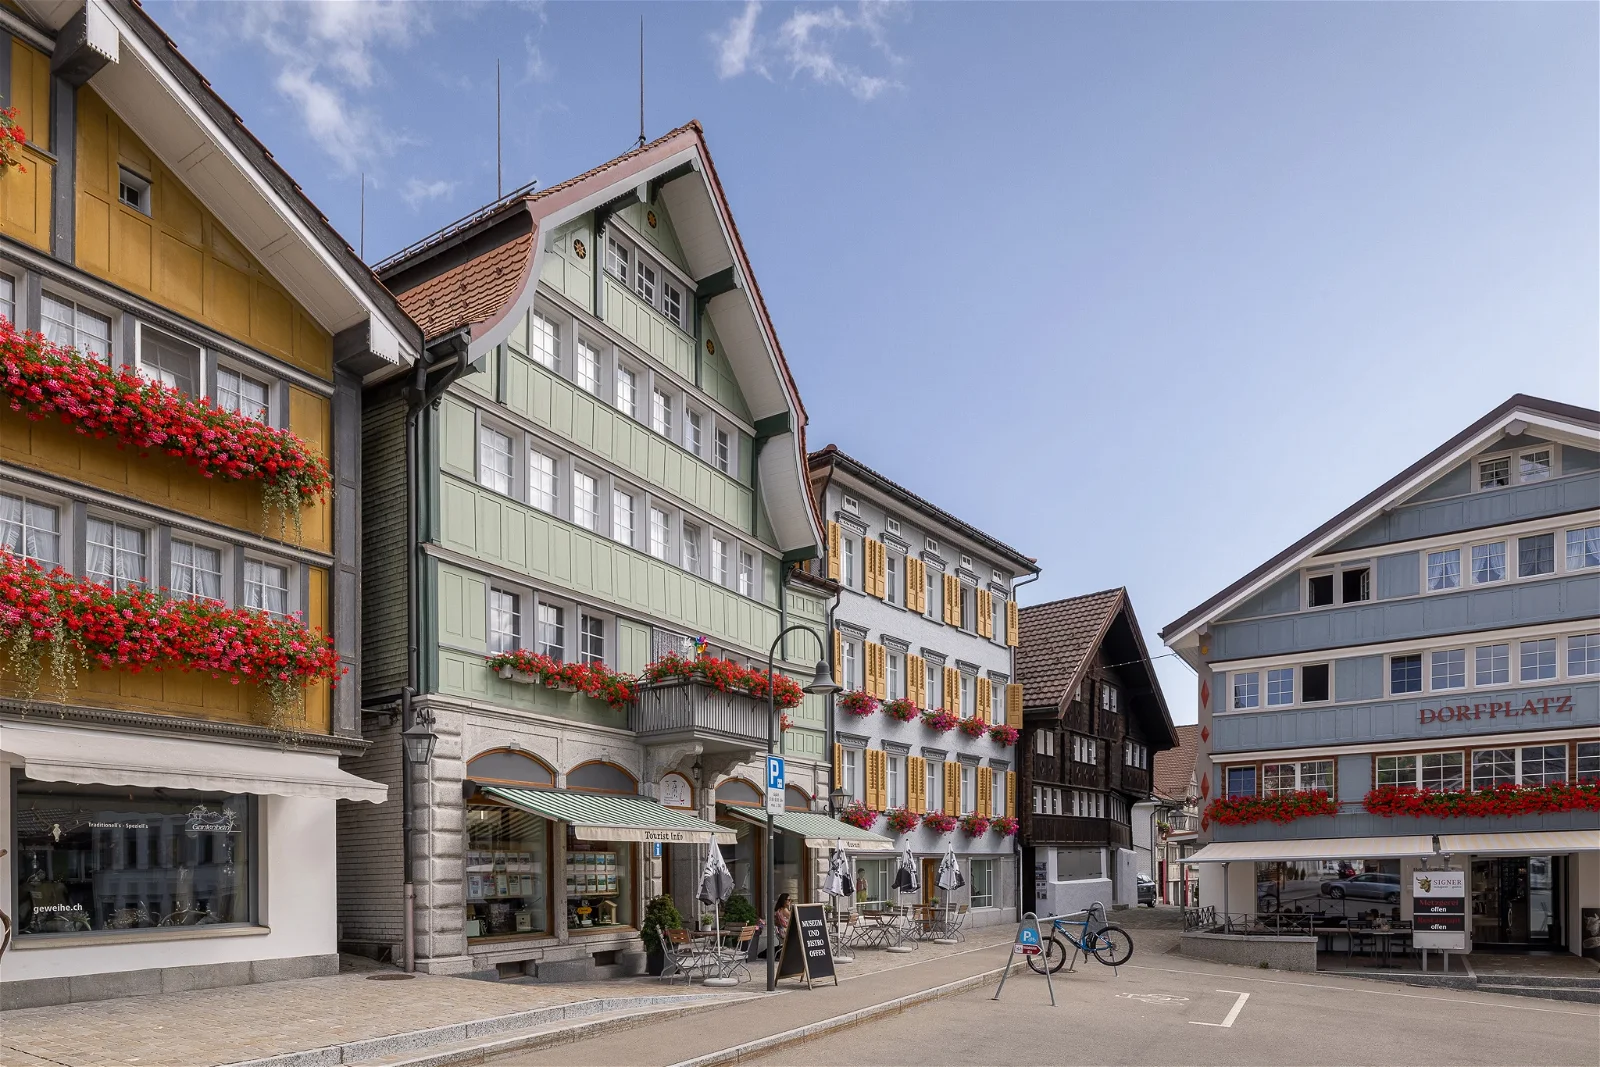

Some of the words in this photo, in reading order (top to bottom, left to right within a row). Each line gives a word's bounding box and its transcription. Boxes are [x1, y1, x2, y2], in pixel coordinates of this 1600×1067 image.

[1419, 695, 1573, 724] DORFPLATZ
[770, 759, 779, 785] P
[644, 830, 669, 841] Tourist
[670, 832, 684, 842] Info
[33, 903, 83, 915] geweihe.ch
[801, 919, 823, 927] MUSEUM
[807, 929, 820, 937] UND
[1023, 930, 1031, 941] P
[806, 939, 825, 947] BISTRO
[809, 948, 826, 957] OFFEN
